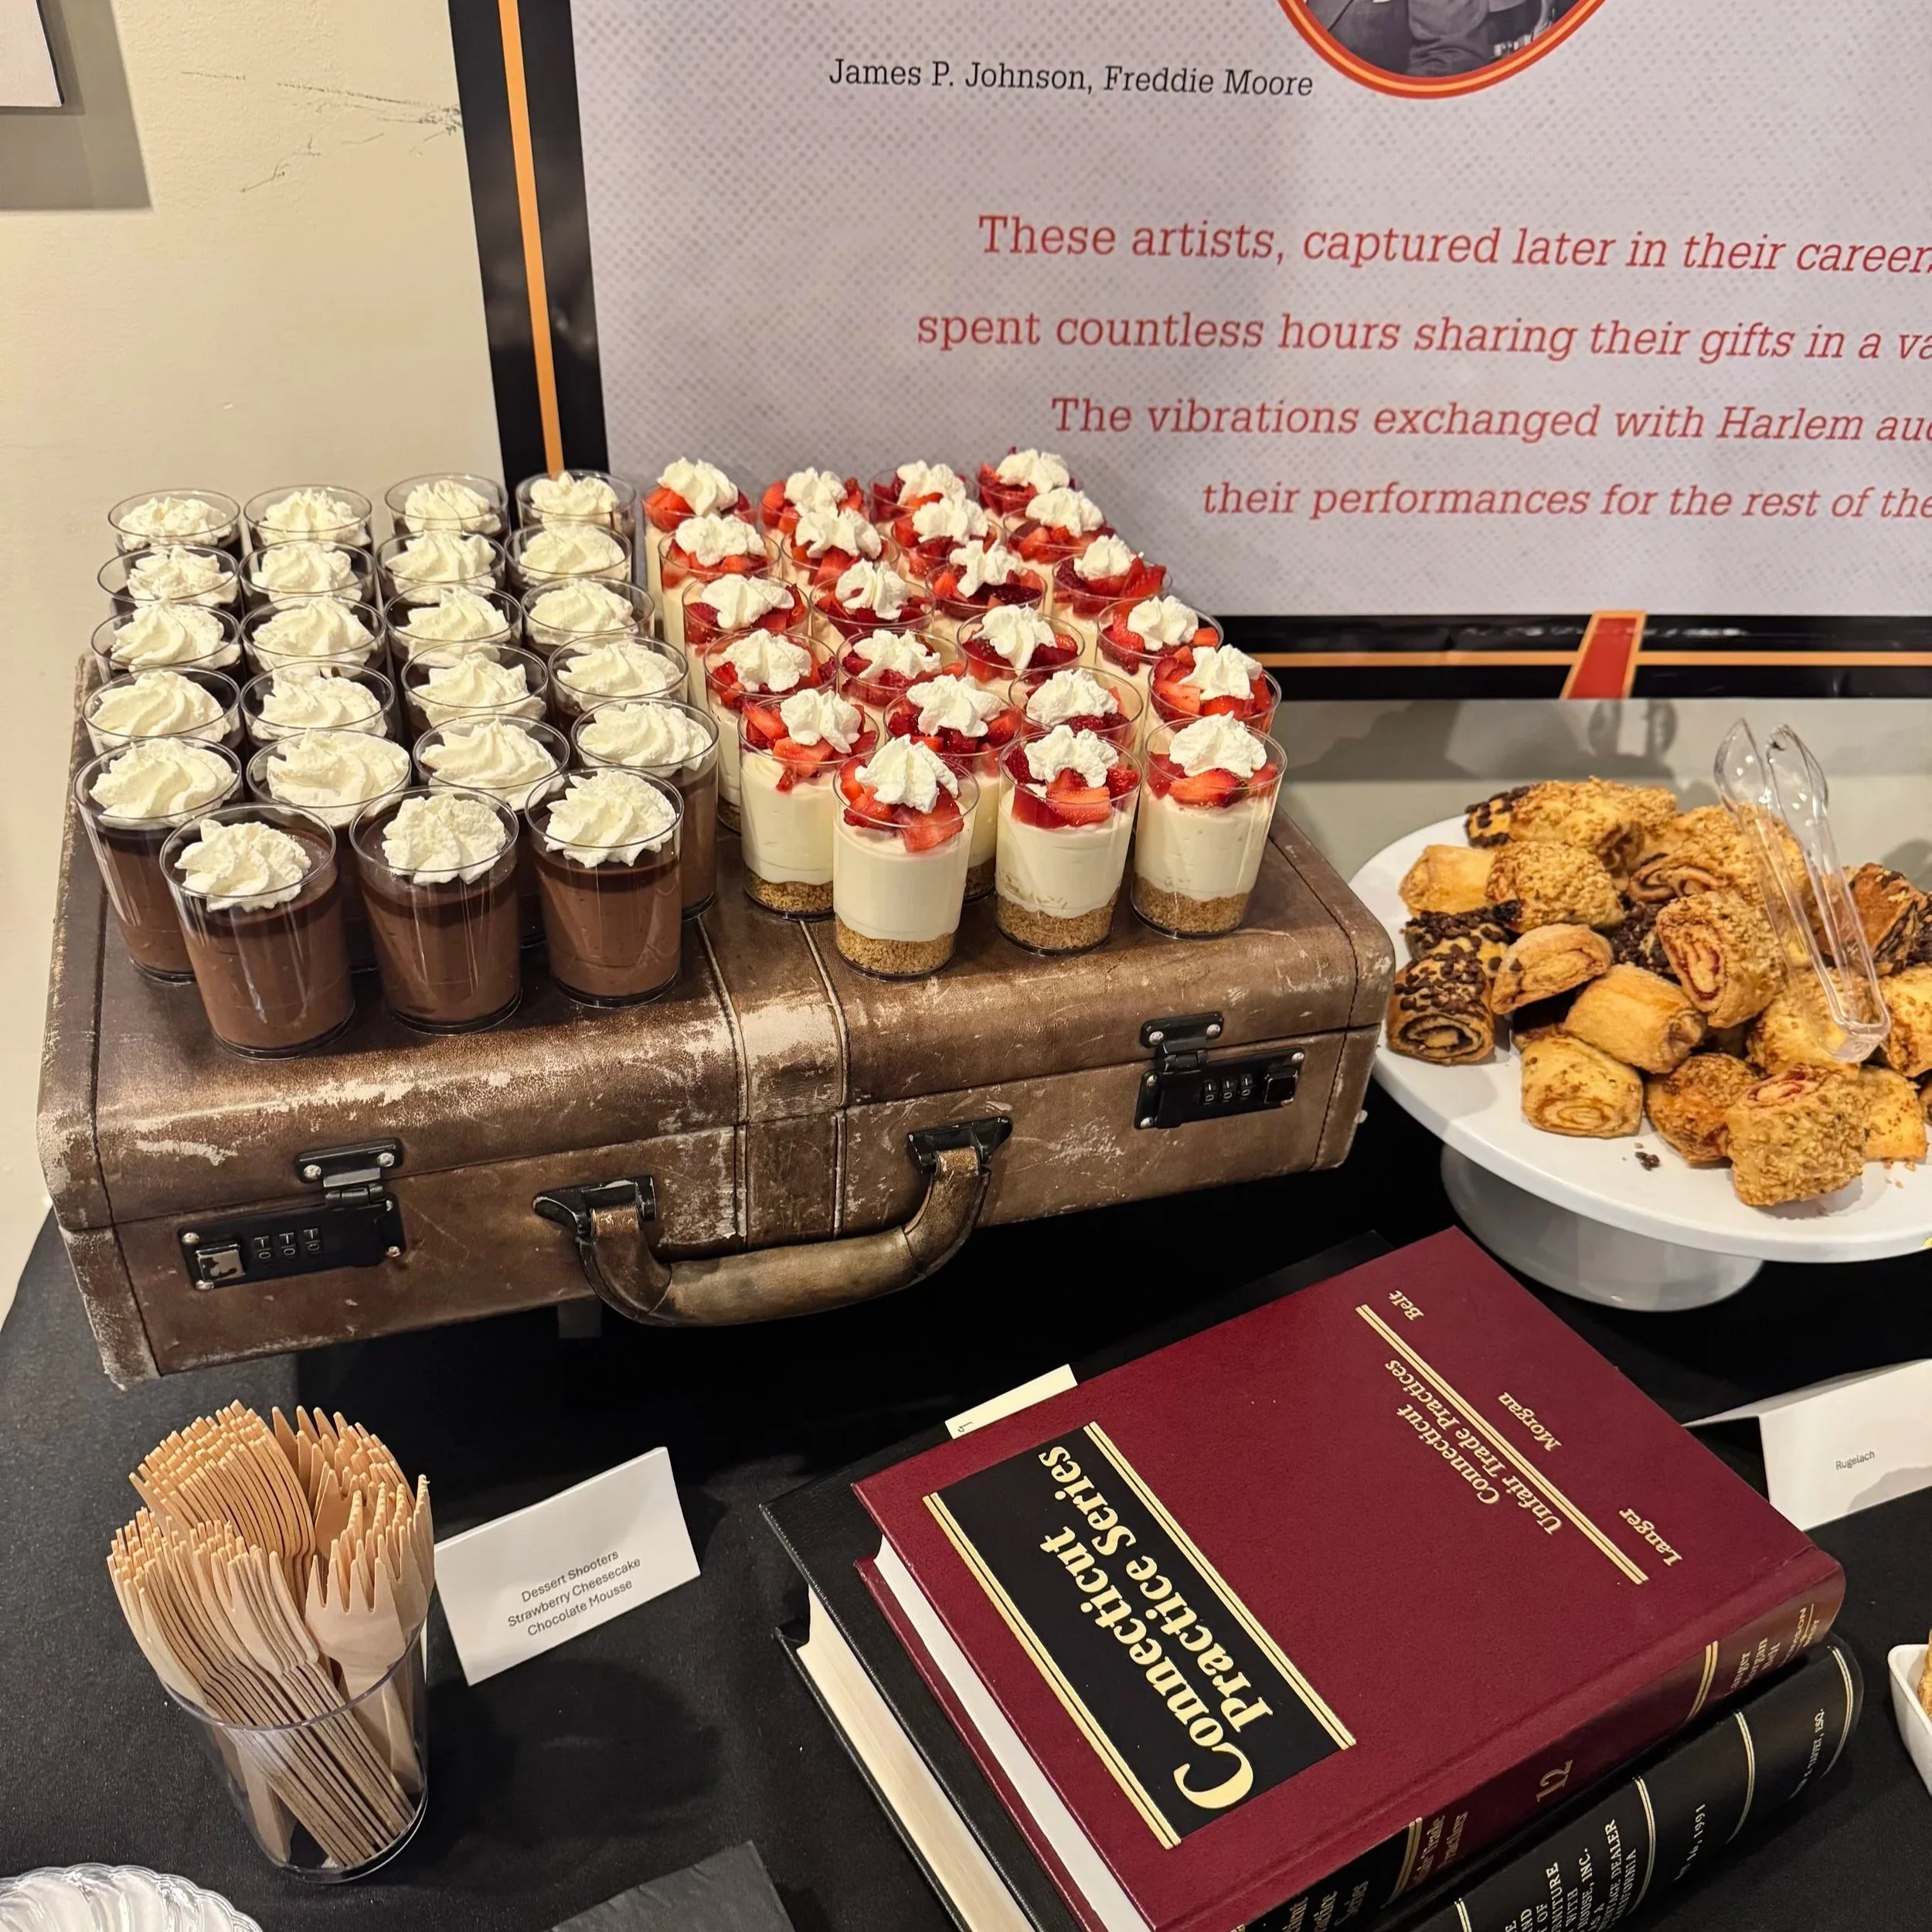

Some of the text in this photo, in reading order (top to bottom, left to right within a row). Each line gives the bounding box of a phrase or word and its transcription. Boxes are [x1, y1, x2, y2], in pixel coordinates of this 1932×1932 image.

[829, 59, 1314, 96] James P. Johnson, Freddie Moore
[978, 215, 1932, 275] These artists, captured later in their career
[917, 312, 1041, 351] spent
[1056, 312, 1264, 349] countless
[1278, 313, 1401, 350] hours
[1413, 317, 1577, 361] sharing
[1589, 320, 1691, 357] their
[1699, 321, 1795, 364] gifts
[1804, 324, 1845, 359] in
[1857, 332, 1881, 359] a
[1052, 397, 1132, 432] The
[1148, 398, 1359, 434] vibrations
[1373, 400, 1601, 444] exchanged
[1614, 405, 1705, 438] with
[1716, 405, 1863, 441] Harlem
[1202, 481, 1300, 514] their
[1309, 481, 1590, 520] performances
[1600, 483, 1658, 516] for
[1668, 485, 1733, 516] the
[1742, 491, 1821, 517] rest
[1831, 486, 1876, 518] of
[1389, 1290, 1424, 1321] Belt
[1384, 1359, 1563, 1536] Unfair Trade Practices
[1498, 1392, 1563, 1452] Morgan
[1396, 1403, 1500, 1505] Connecticut
[1835, 1451, 1876, 1470] Rugelach
[1618, 1508, 1683, 1566] Langer
[508, 1558, 641, 1627] Strawberry Cheesecake
[522, 1551, 619, 1603] Dessert Shooters
[1038, 1445, 1274, 1733] Practice Series
[527, 1580, 633, 1636] Chocolate Mousse
[1039, 1526, 1254, 1809] Connecticut
[1815, 1708, 1825, 1733] ESQ.
[1536, 1759, 1573, 1804] 12
[1694, 1804, 1706, 1838] 1991
[1579, 1848, 1593, 1883] INC.
[1605, 1819, 1621, 1879] DEALER
[1546, 1862, 1564, 1932] RNITURE
[1565, 1887, 1578, 1927] WITH
[1610, 1849, 1636, 1923] LIFORNIA
